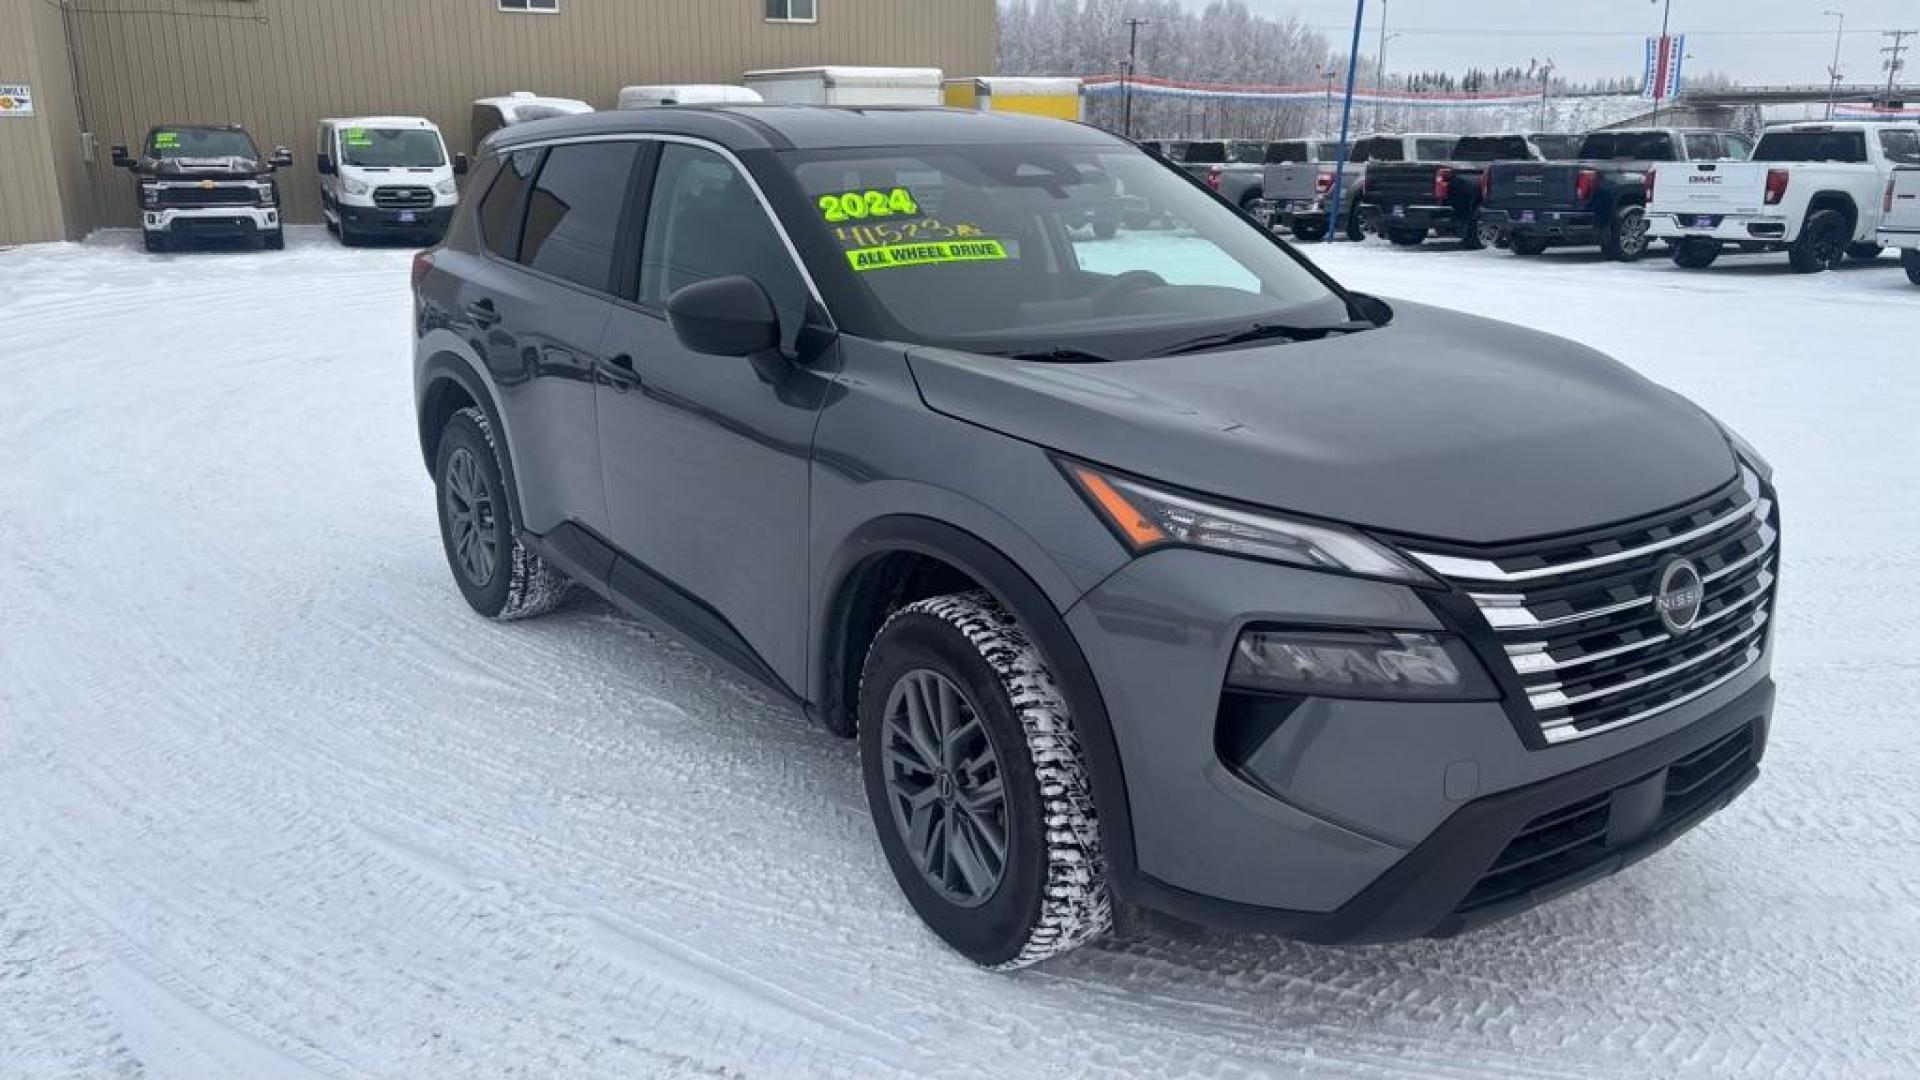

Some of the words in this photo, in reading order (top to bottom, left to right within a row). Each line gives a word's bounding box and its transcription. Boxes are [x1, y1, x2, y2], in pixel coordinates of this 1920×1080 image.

[1689, 175, 1723, 185] GMC
[819, 188, 918, 221] 2024
[857, 251, 887, 266] ALL
[890, 245, 944, 261] WHEEL
[950, 243, 996, 256] DRIVE
